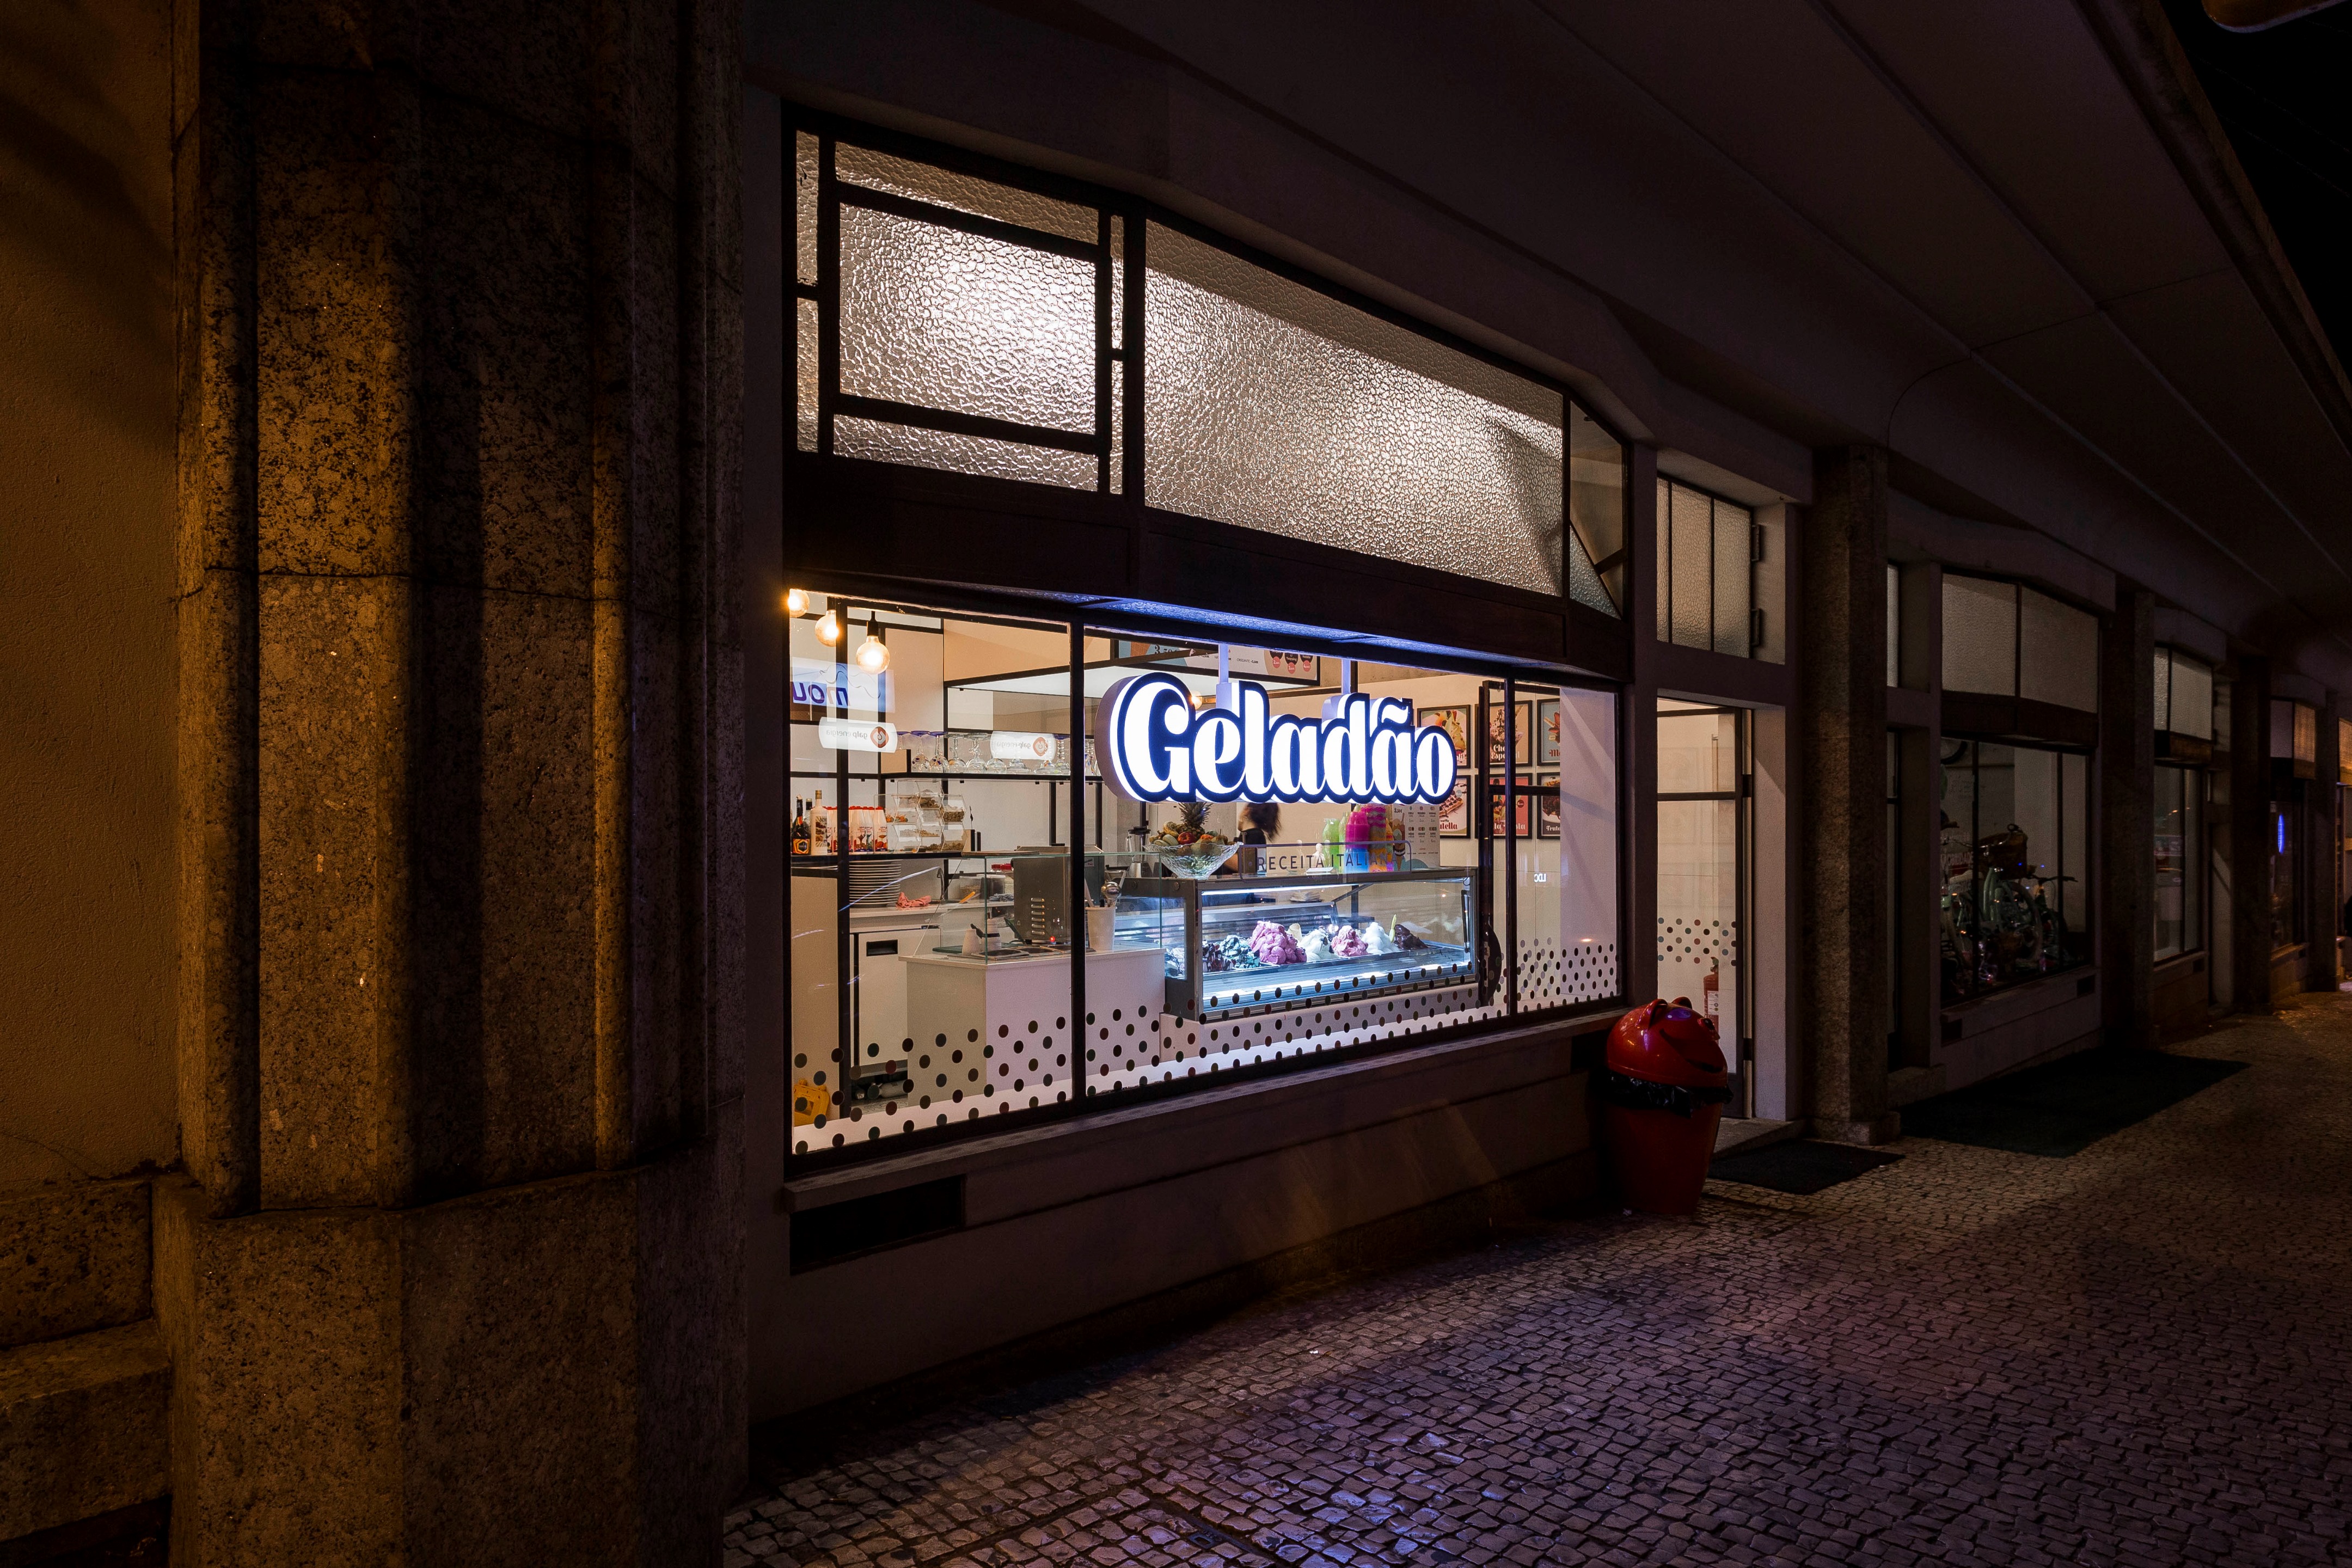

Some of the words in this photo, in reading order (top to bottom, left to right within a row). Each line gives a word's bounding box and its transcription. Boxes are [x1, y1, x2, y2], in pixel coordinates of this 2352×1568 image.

[1122, 680, 1451, 797] Geladão
[1257, 854, 1324, 871] RECEITA
[1331, 853, 1398, 868] ITALIANA
